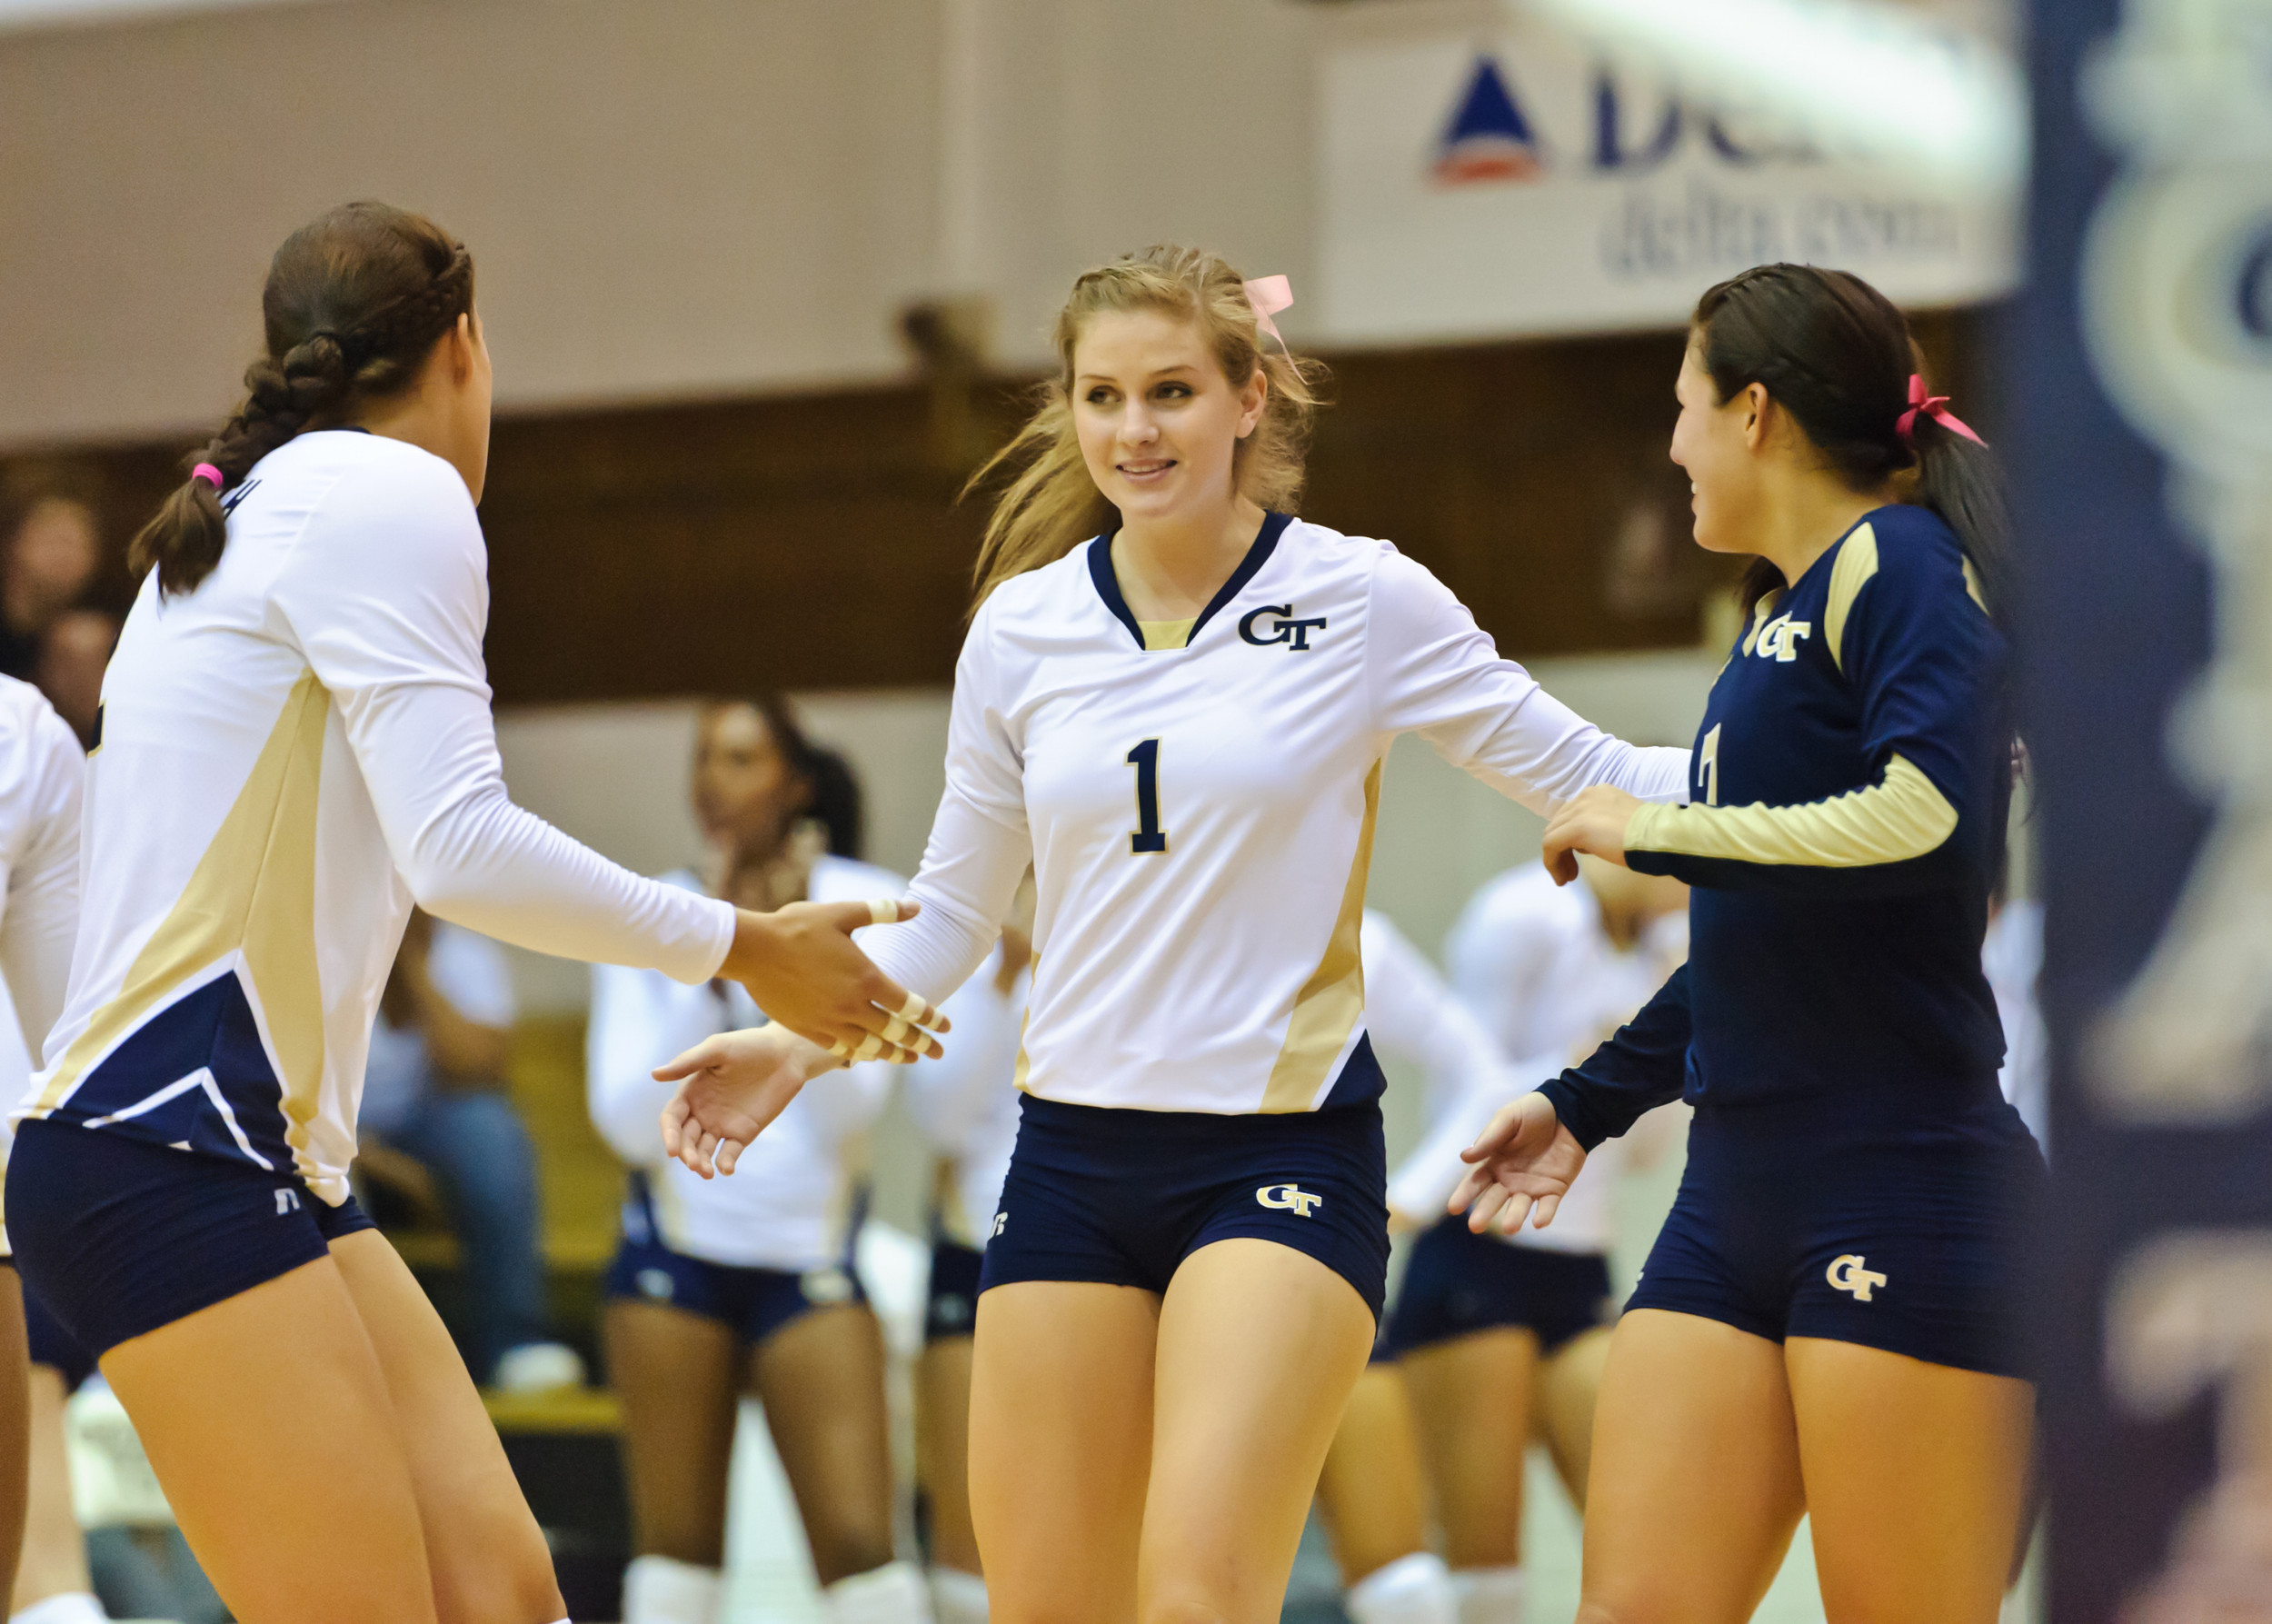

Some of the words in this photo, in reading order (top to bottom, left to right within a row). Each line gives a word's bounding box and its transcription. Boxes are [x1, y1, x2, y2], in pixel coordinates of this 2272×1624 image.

[1238, 603, 1327, 652] GT
[1757, 610, 1811, 663] GT
[1123, 735, 1169, 856] 1
[1256, 1183, 1322, 1218] GT
[1826, 1253, 1888, 1302] GT
